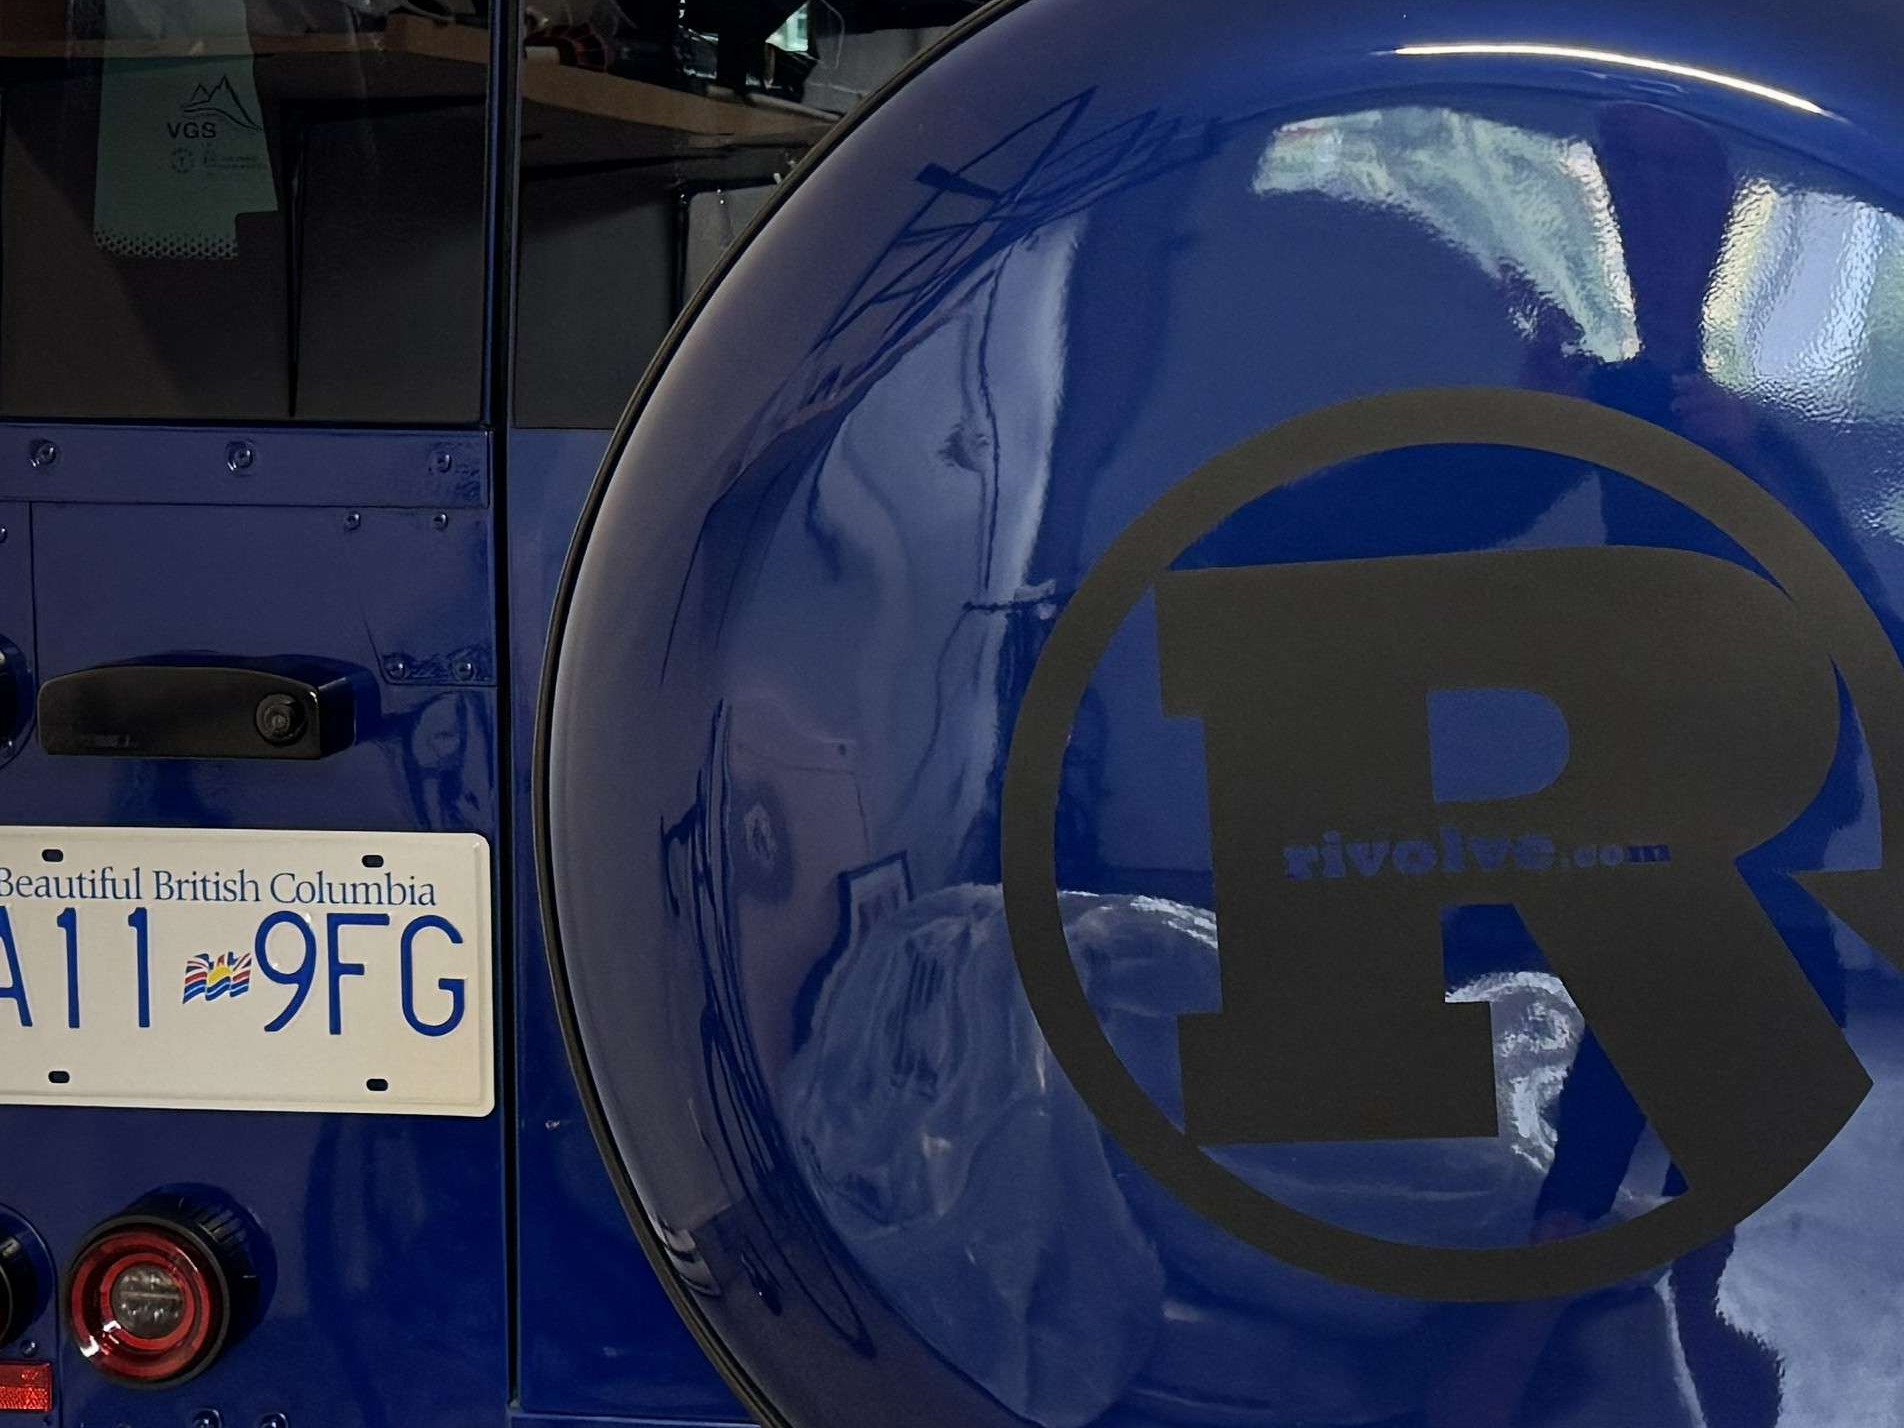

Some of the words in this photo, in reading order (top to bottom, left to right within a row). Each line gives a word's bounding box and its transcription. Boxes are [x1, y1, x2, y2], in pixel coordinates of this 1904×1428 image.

[167, 122, 216, 139] VGS
[1151, 545, 1874, 1212] R
[1283, 826, 1670, 881] rivolve.com
[152, 868, 261, 903] British
[270, 871, 437, 907] Columbia
[253, 910, 465, 1037] 9FG
